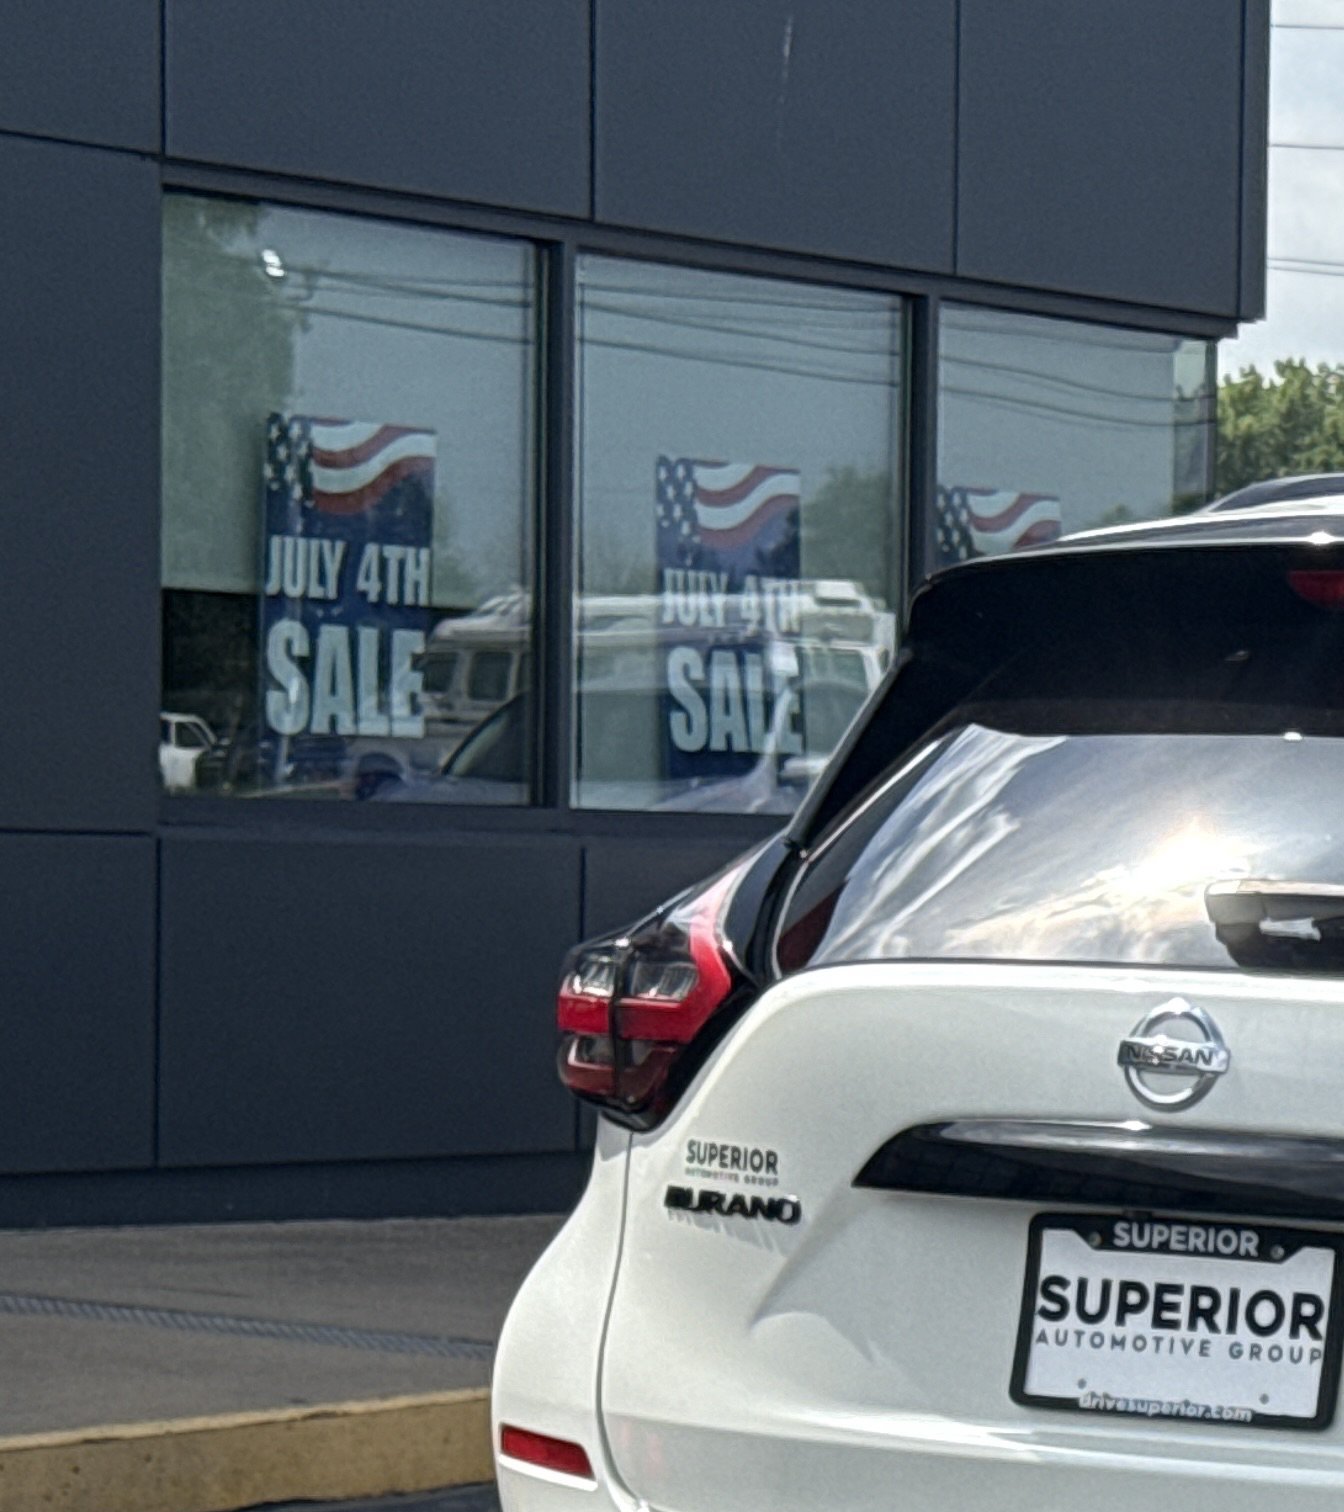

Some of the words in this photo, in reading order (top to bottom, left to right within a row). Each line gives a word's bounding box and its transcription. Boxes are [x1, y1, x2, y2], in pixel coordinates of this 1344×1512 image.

[265, 535, 346, 600] JULY
[357, 542, 430, 606] 4TH
[662, 567, 728, 628] JULY
[740, 574, 800, 635] 4TH
[265, 617, 426, 738] SALE
[1127, 1044, 1214, 1067] NISSAN
[686, 1138, 778, 1175] SUPERIOR
[1113, 1221, 1259, 1257] SUPERIOR
[1036, 1274, 1325, 1341] SUPERIOR
[1035, 1328, 1211, 1358] AUTOMOTIVE
[1229, 1341, 1323, 1365] GROUP
